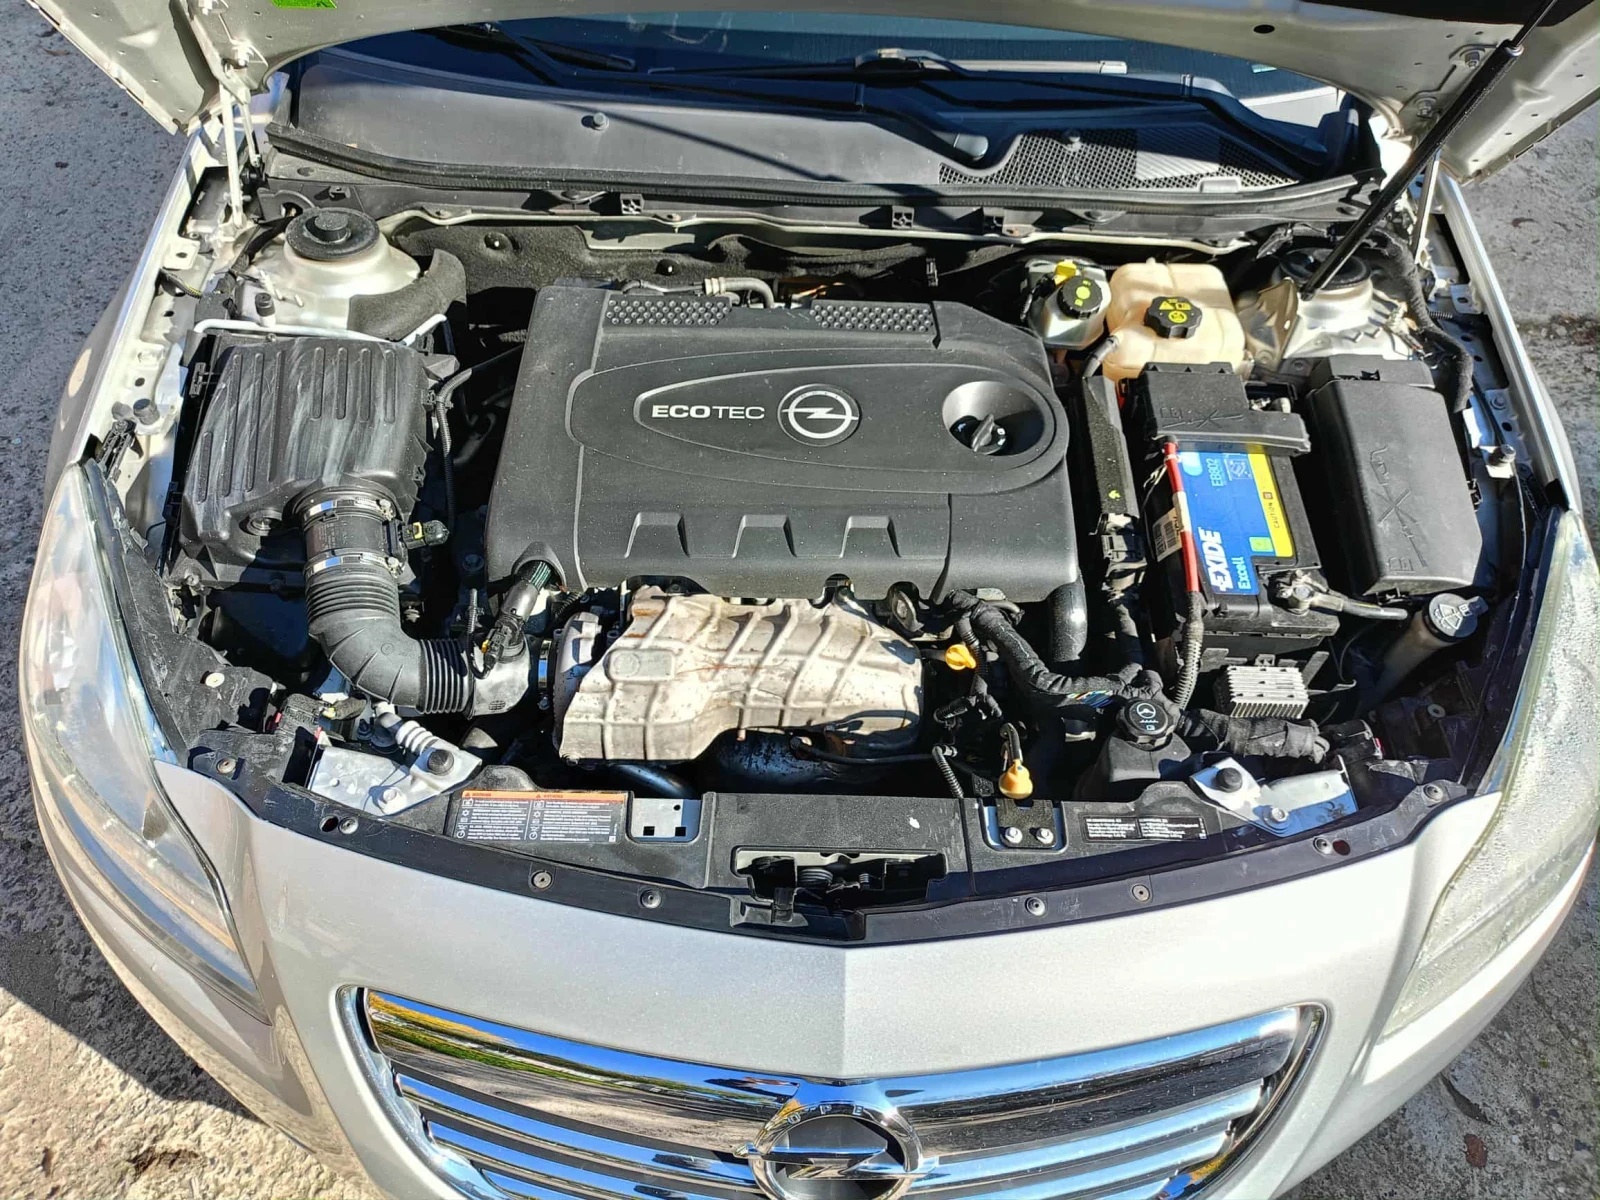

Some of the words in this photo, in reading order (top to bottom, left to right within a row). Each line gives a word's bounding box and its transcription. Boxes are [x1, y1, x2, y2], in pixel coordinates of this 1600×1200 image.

[651, 404, 765, 420] ECOTEC
[1198, 526, 1234, 591] EXIDE
[1231, 556, 1251, 590] Excell
